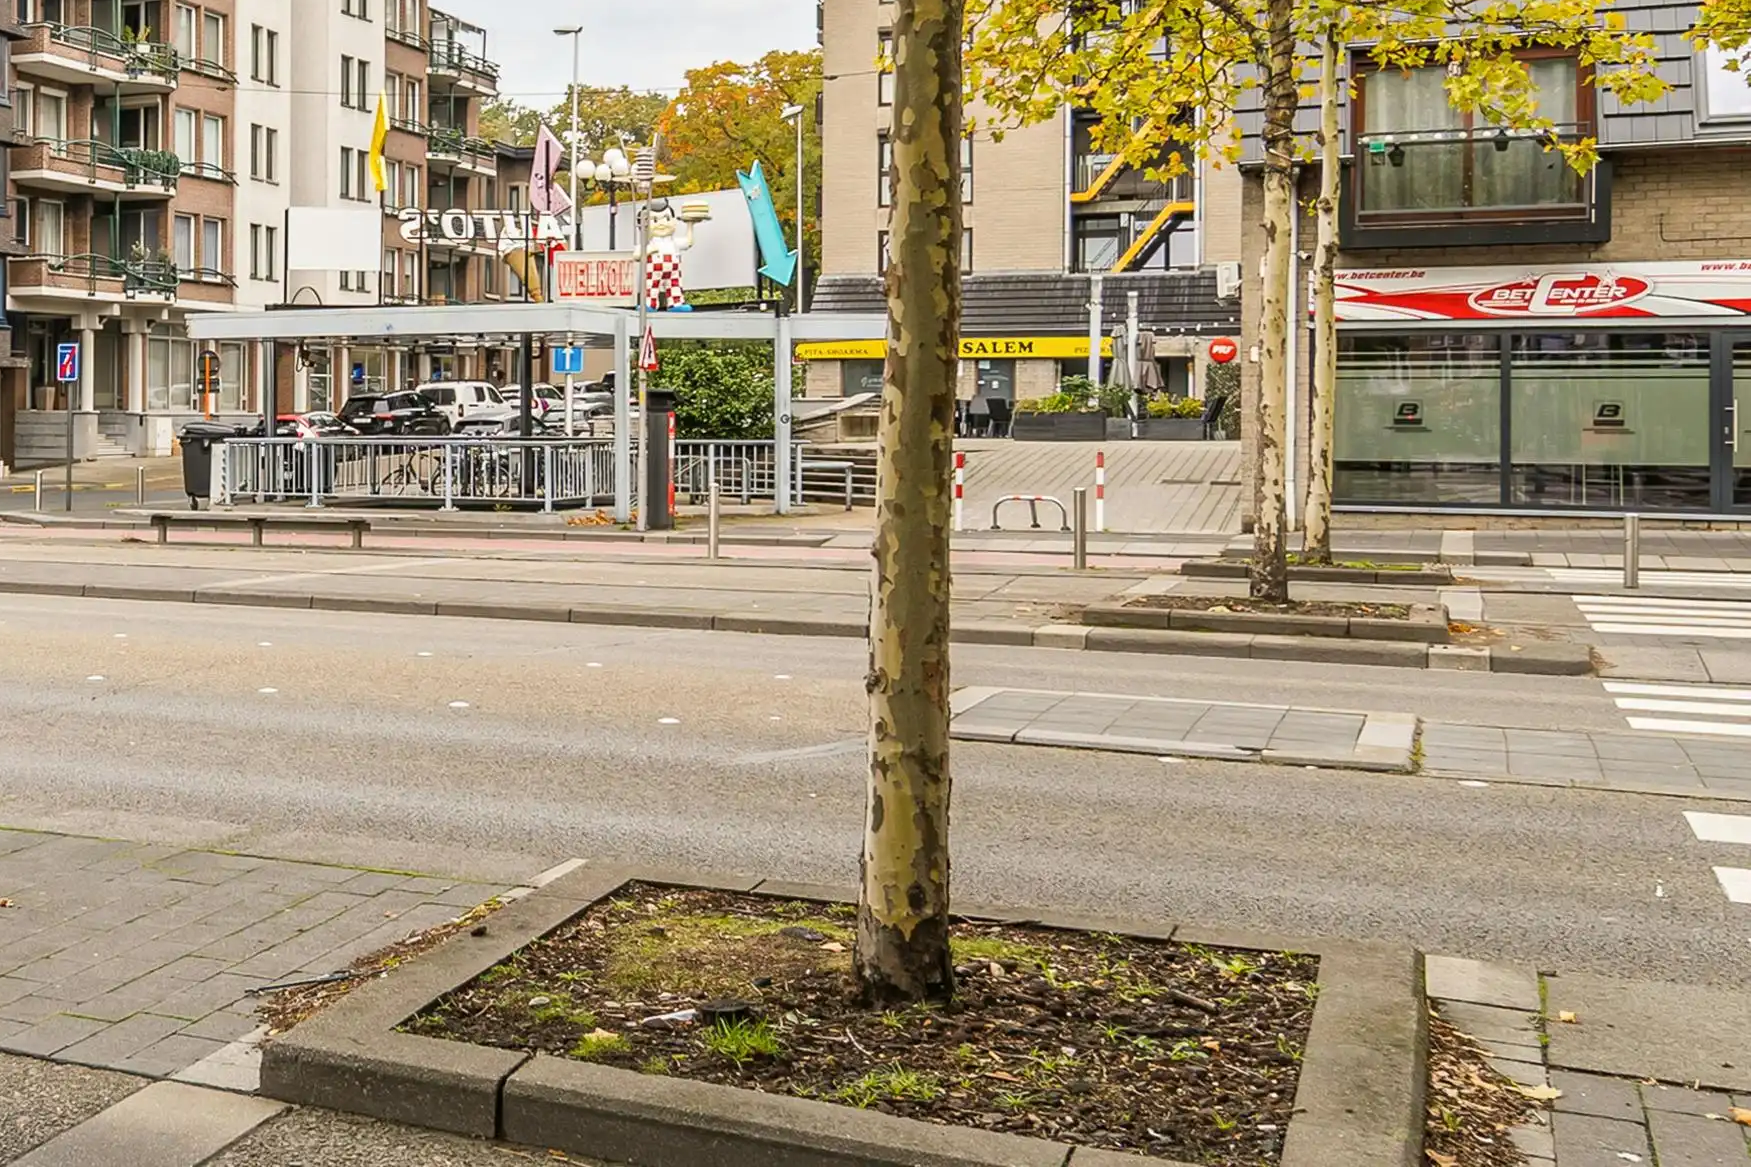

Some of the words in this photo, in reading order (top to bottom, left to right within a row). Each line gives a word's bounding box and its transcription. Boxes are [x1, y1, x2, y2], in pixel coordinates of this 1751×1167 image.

[558, 260, 634, 296] WELKOM
[1334, 271, 1426, 280] w.betcenter.be
[962, 341, 1034, 354] SALEM
